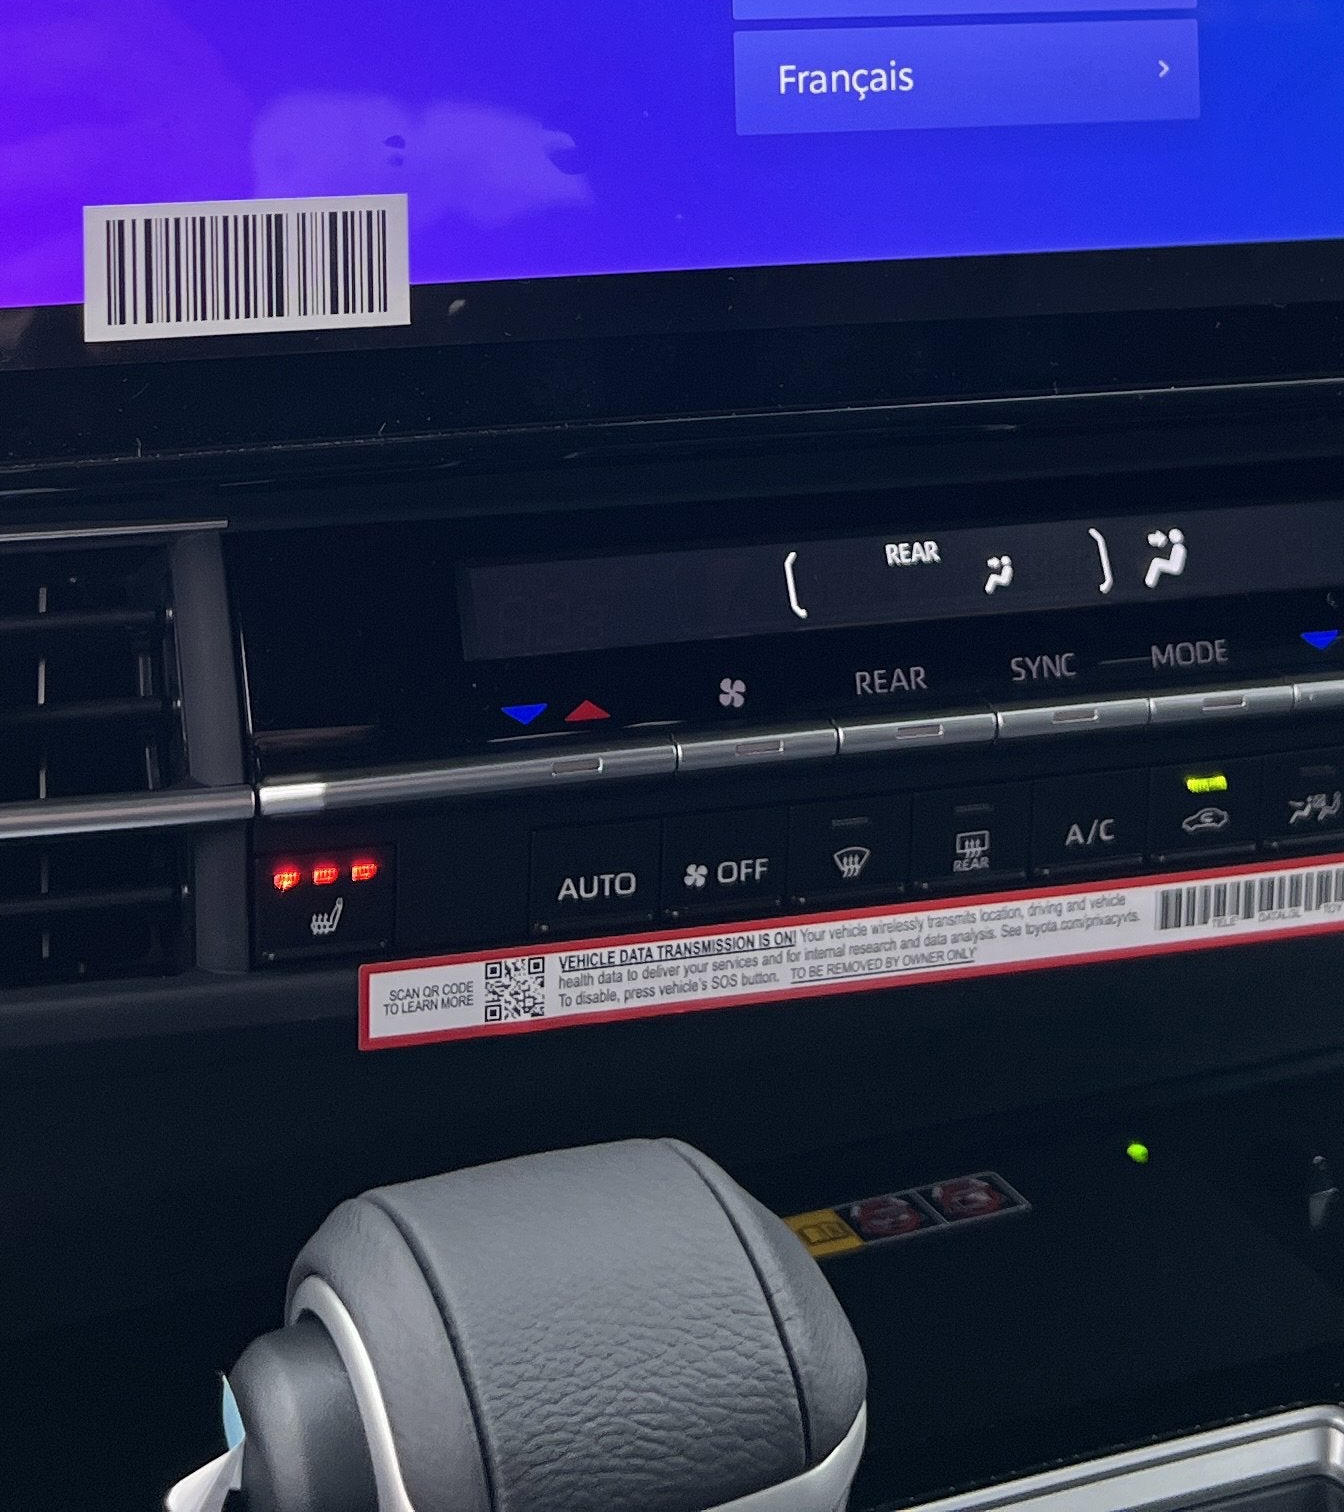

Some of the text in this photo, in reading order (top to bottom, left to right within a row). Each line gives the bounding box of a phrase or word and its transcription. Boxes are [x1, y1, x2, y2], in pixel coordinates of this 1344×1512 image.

[778, 60, 914, 101] Français
[885, 539, 942, 567] REAR
[1010, 651, 1077, 682] SYNC
[1151, 638, 1229, 669] MODE
[856, 665, 927, 696] REAR
[1065, 818, 1116, 847] A/C
[716, 857, 770, 885] OFF
[953, 855, 990, 872] REAR
[557, 871, 637, 902] AUTO
[558, 950, 615, 970] VEHICLE
[619, 945, 653, 963] DATA
[656, 934, 754, 959] TRANSMISSION
[758, 932, 770, 947] IS
[799, 926, 824, 943] Your
[828, 922, 867, 940] vehicle
[871, 915, 923, 938] wirelessly
[927, 909, 976, 929] transmits
[979, 903, 1024, 924] location,
[1027, 899, 1062, 920] driving
[1066, 896, 1085, 912] and
[1089, 892, 1125, 910] vehicle
[558, 971, 594, 990] health
[597, 968, 622, 985] data
[626, 967, 638, 982] to
[641, 962, 680, 980] deliver
[683, 961, 708, 978] your
[712, 953, 758, 972] services
[761, 950, 783, 966] and
[786, 948, 800, 963] for
[803, 943, 845, 961] internal
[848, 937, 896, 956] research
[899, 934, 920, 950] and
[923, 931, 947, 947] data
[1000, 922, 1021, 937] See
[389, 980, 473, 1002] SCAN QR CODE
[558, 946, 976, 1008] To disable, press vehicle's SOS button. TO BE REMOVED BY OWNER ONLY
[384, 993, 474, 1017] TO LEARN MORE
